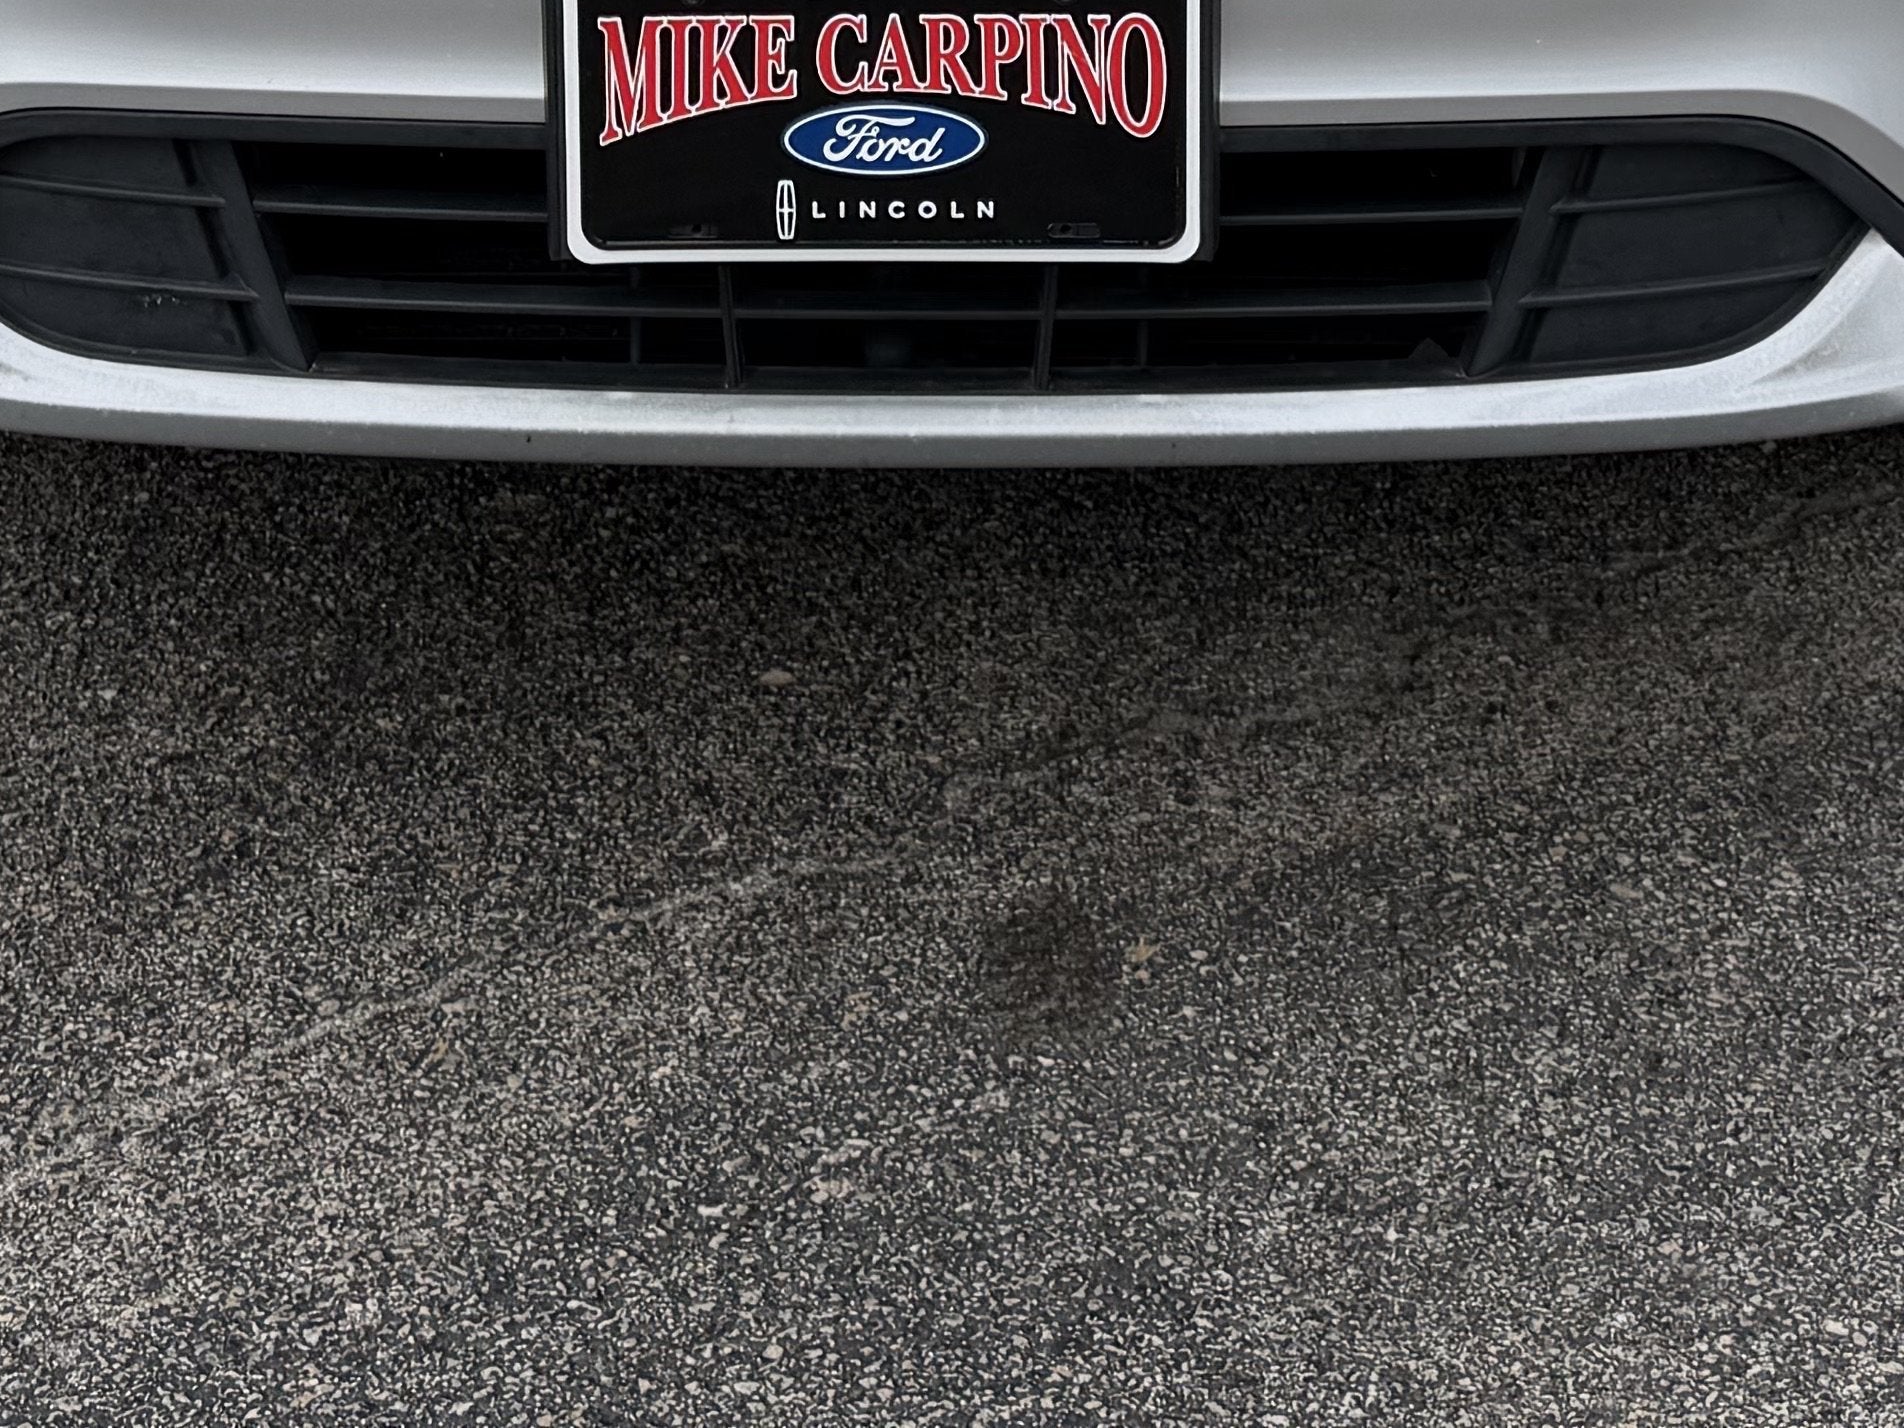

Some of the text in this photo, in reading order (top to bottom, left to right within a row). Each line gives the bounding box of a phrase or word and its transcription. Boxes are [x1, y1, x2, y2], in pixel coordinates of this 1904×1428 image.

[598, 12, 1167, 146] MIKE CARPINO
[823, 115, 944, 163] Ford
[812, 199, 995, 220] LINCOLN
